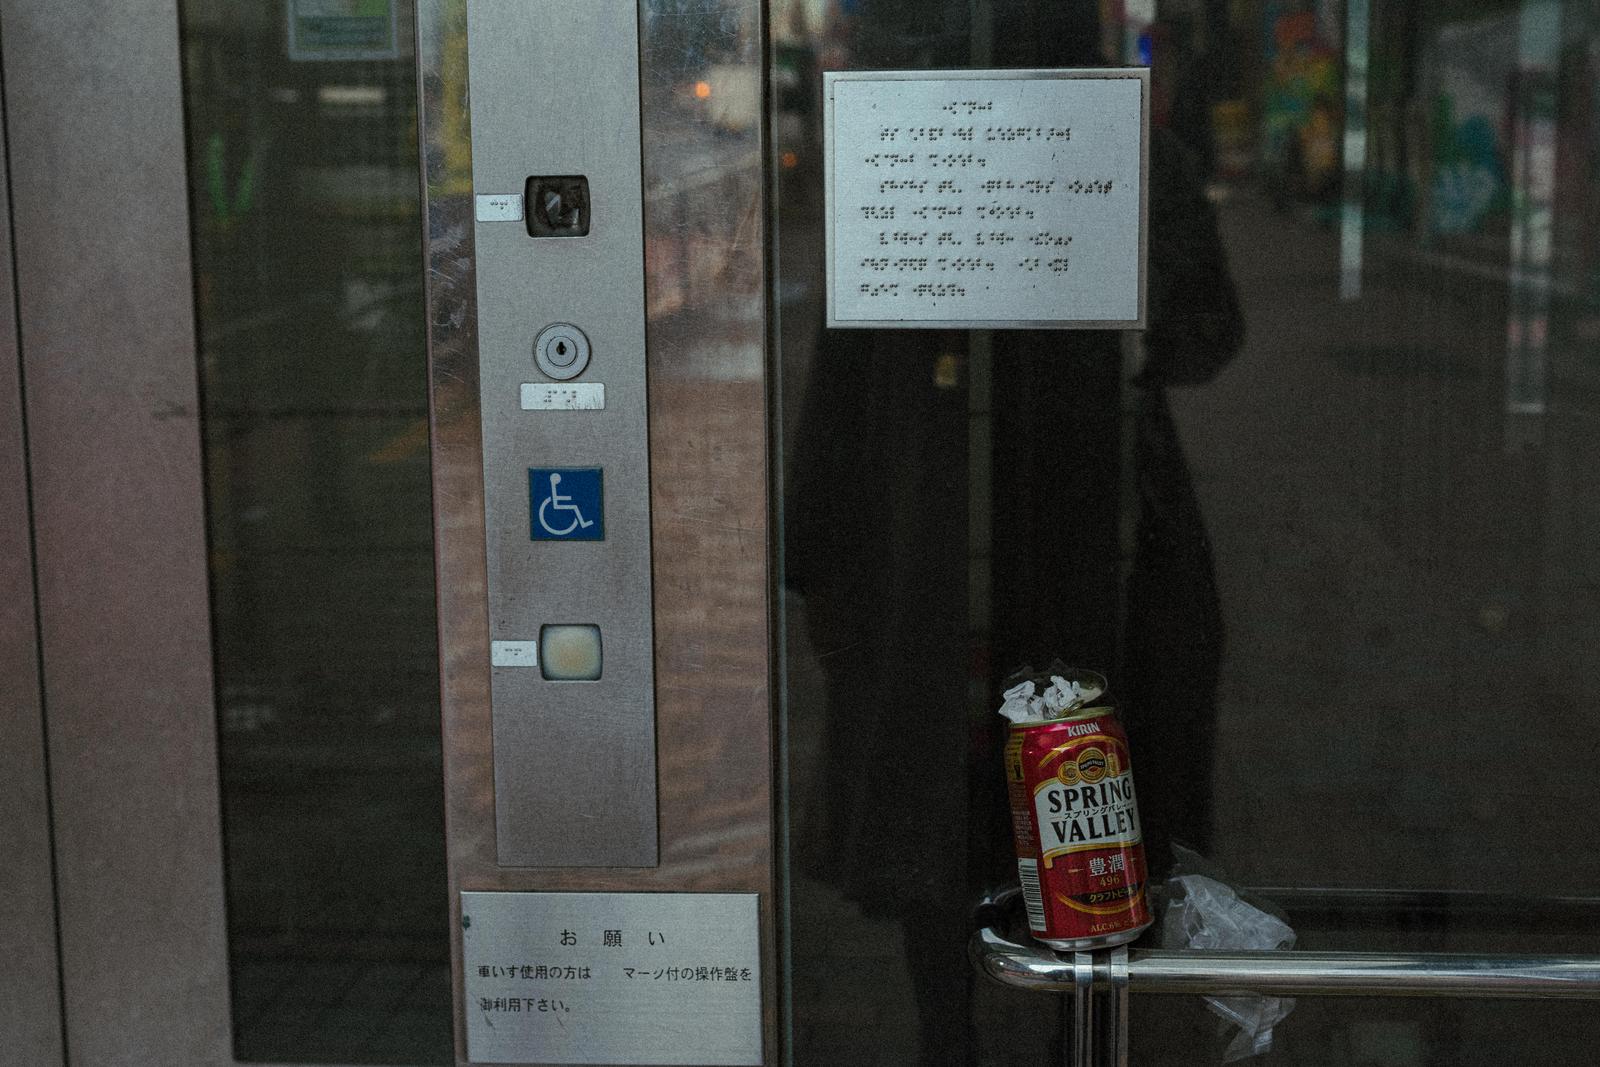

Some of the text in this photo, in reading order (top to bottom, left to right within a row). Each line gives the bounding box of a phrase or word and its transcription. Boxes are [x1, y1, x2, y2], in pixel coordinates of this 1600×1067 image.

[1067, 722, 1101, 738] KIRIN
[1047, 777, 1132, 814] SPRING
[1050, 807, 1136, 844] VALLEY
[1089, 853, 1125, 877] 豊潤
[1100, 875, 1121, 887] 496
[478, 964, 592, 980] 車いす使用の方は
